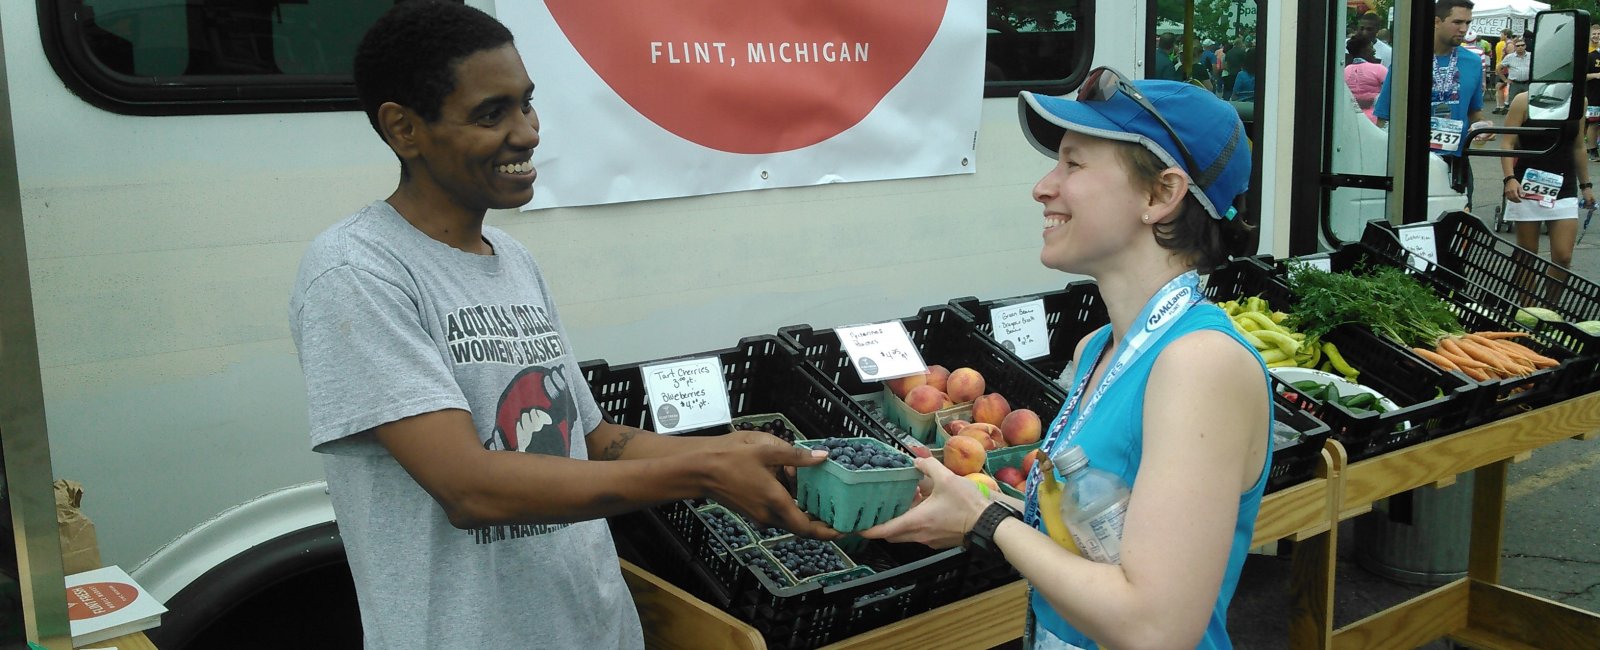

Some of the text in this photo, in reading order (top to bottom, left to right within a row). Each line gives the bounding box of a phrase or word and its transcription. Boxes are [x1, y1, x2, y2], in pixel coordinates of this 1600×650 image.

[650, 41, 869, 67] FLINT, MICHIGAN
[1522, 182, 1558, 197] 6436
[1159, 287, 1189, 316] McLaren
[451, 338, 524, 365] WOMEN'S
[654, 364, 710, 380] Tart Cherries
[660, 388, 706, 402] Blueberries
